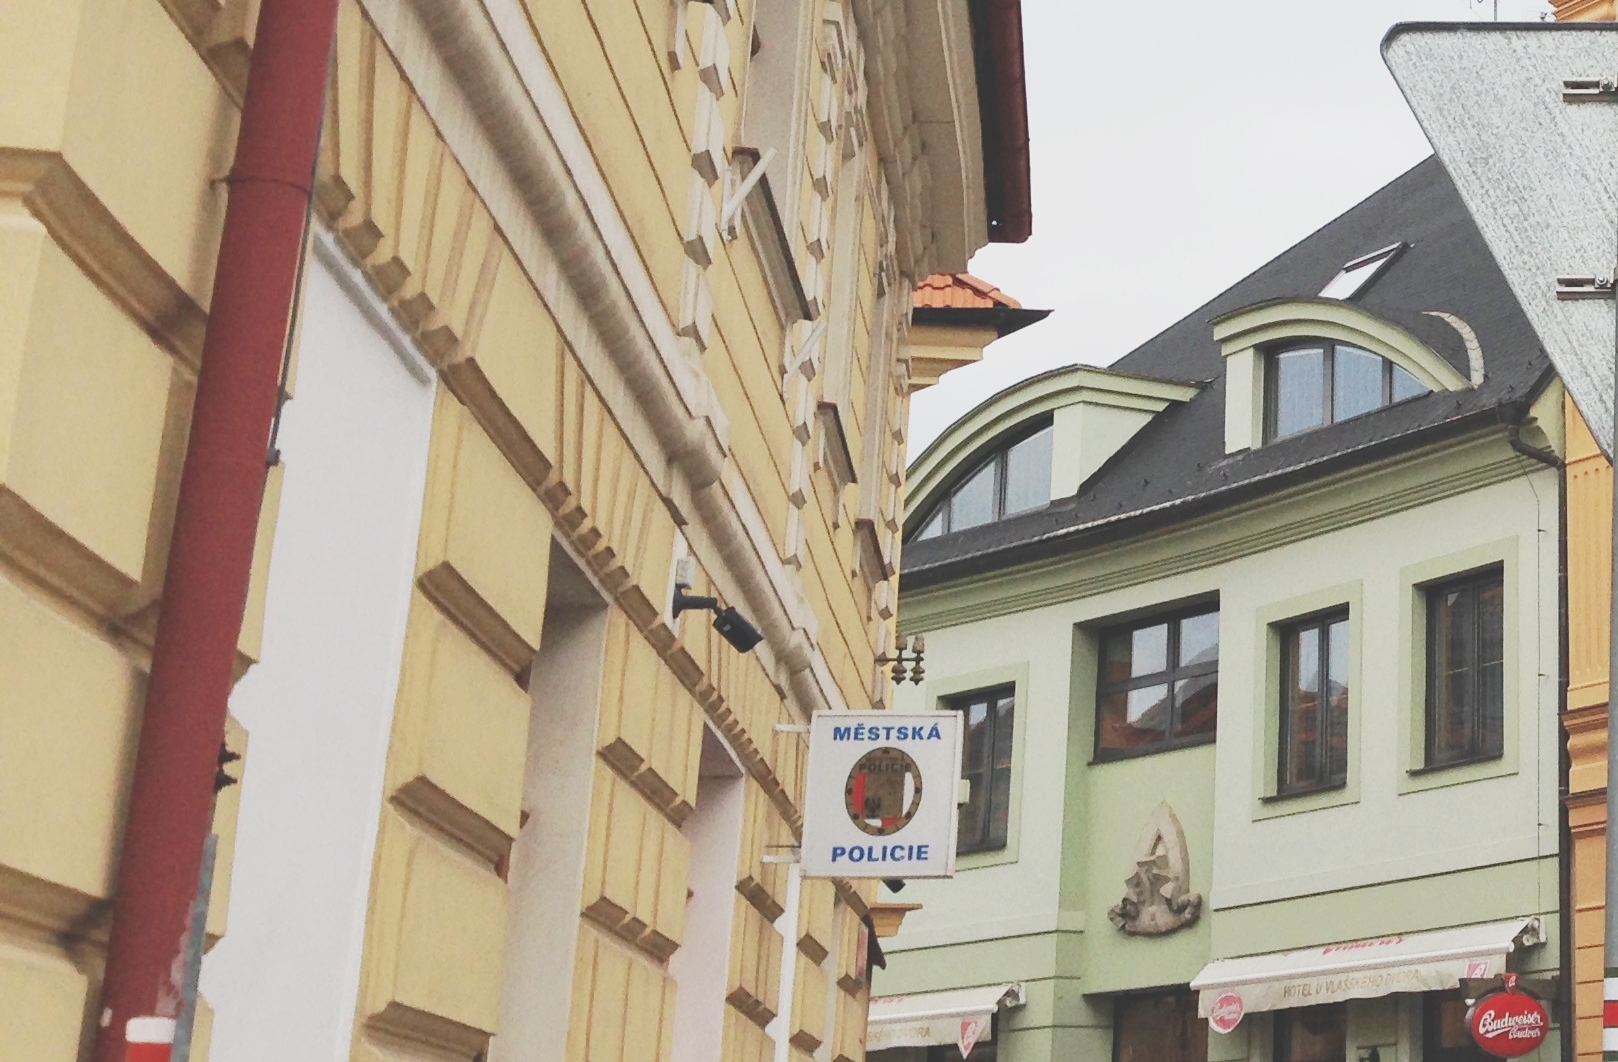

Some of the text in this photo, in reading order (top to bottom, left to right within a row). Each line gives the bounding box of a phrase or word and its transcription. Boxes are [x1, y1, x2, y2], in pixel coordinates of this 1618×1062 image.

[833, 723, 942, 741] MĚSTSKÁ
[859, 763, 912, 774] POLICIE
[831, 844, 930, 862] POLICIE
[1283, 984, 1312, 999] HOTEL
[1479, 1010, 1542, 1035] Budweiser
